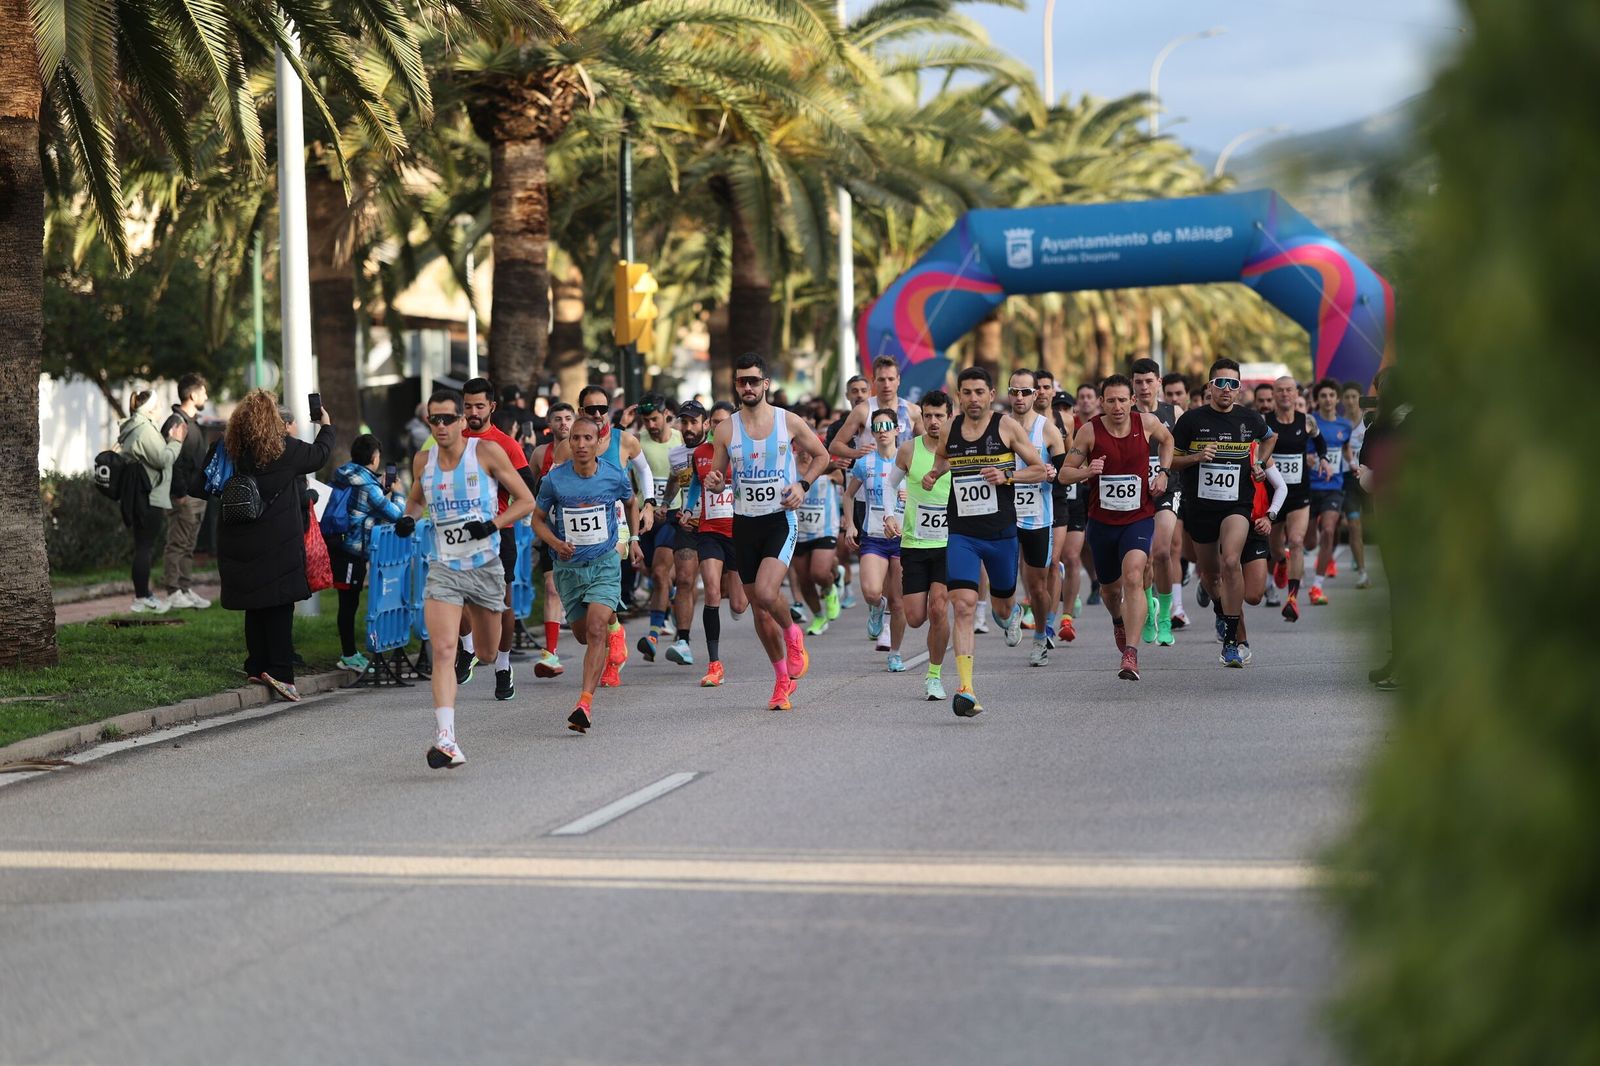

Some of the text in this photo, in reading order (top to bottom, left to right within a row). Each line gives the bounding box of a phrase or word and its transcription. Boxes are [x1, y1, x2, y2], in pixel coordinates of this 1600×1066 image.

[1041, 226, 1234, 253] Ayuntamiento de Málaga
[1204, 472, 1235, 488] 340
[745, 486, 775, 502] 369
[960, 485, 991, 502] 200
[1015, 491, 1035, 505] 52
[1105, 483, 1136, 499] 268
[428, 496, 481, 513] málaga
[570, 515, 602, 532] 151
[799, 511, 821, 524] 347
[443, 528, 473, 546] 82
